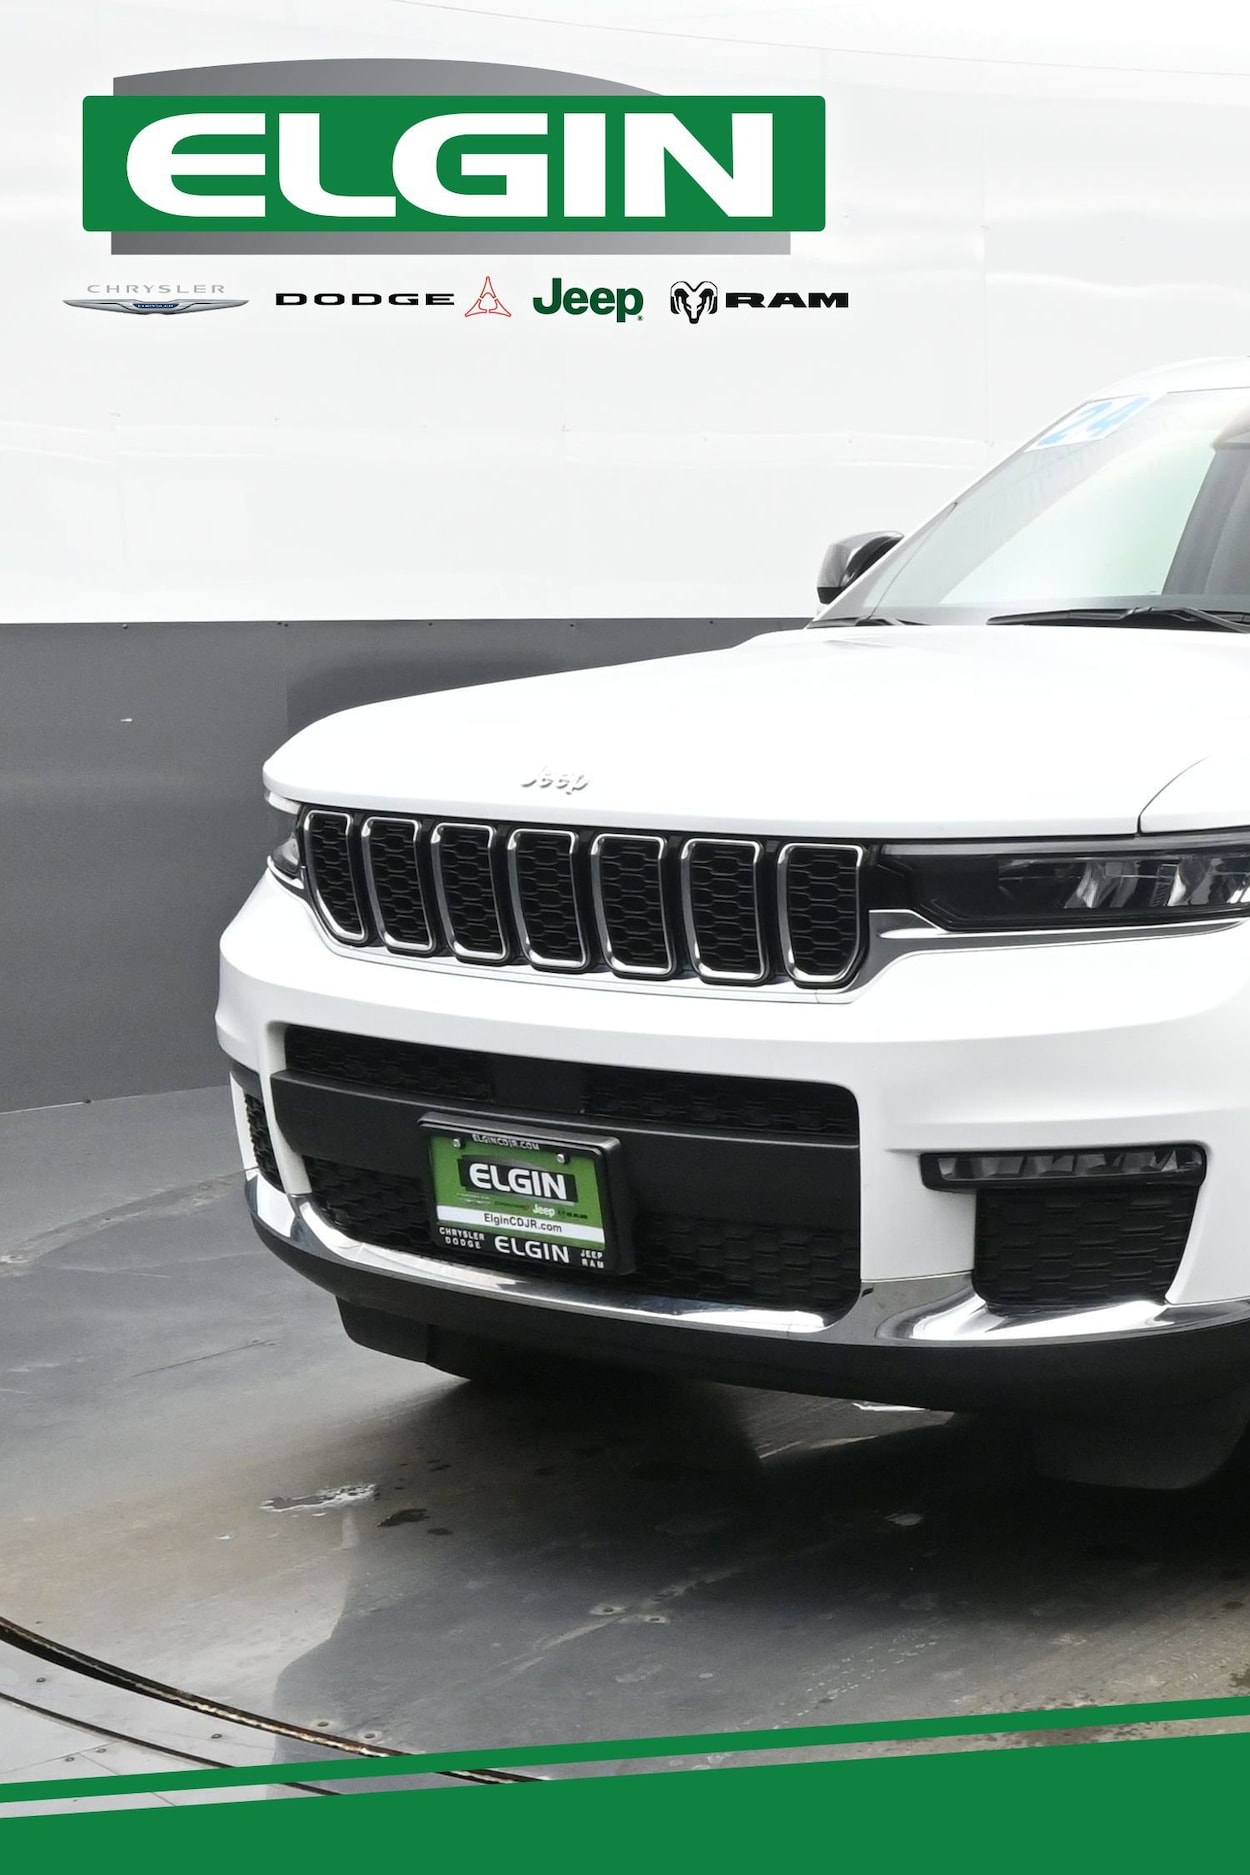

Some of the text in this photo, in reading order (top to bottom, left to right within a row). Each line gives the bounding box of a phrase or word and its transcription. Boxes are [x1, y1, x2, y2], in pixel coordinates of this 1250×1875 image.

[472, 1133, 540, 1151] ELGINCDJR.COM
[469, 1162, 567, 1200] ELGIN
[533, 1203, 555, 1217] Jeep
[484, 1212, 563, 1233] ElginCDJR.com
[439, 1226, 485, 1241] CHRYSLER
[445, 1236, 481, 1249] DODGE
[494, 1235, 569, 1264] ELGIN
[580, 1248, 603, 1260] JEEP
[581, 1258, 604, 1269] RAM
